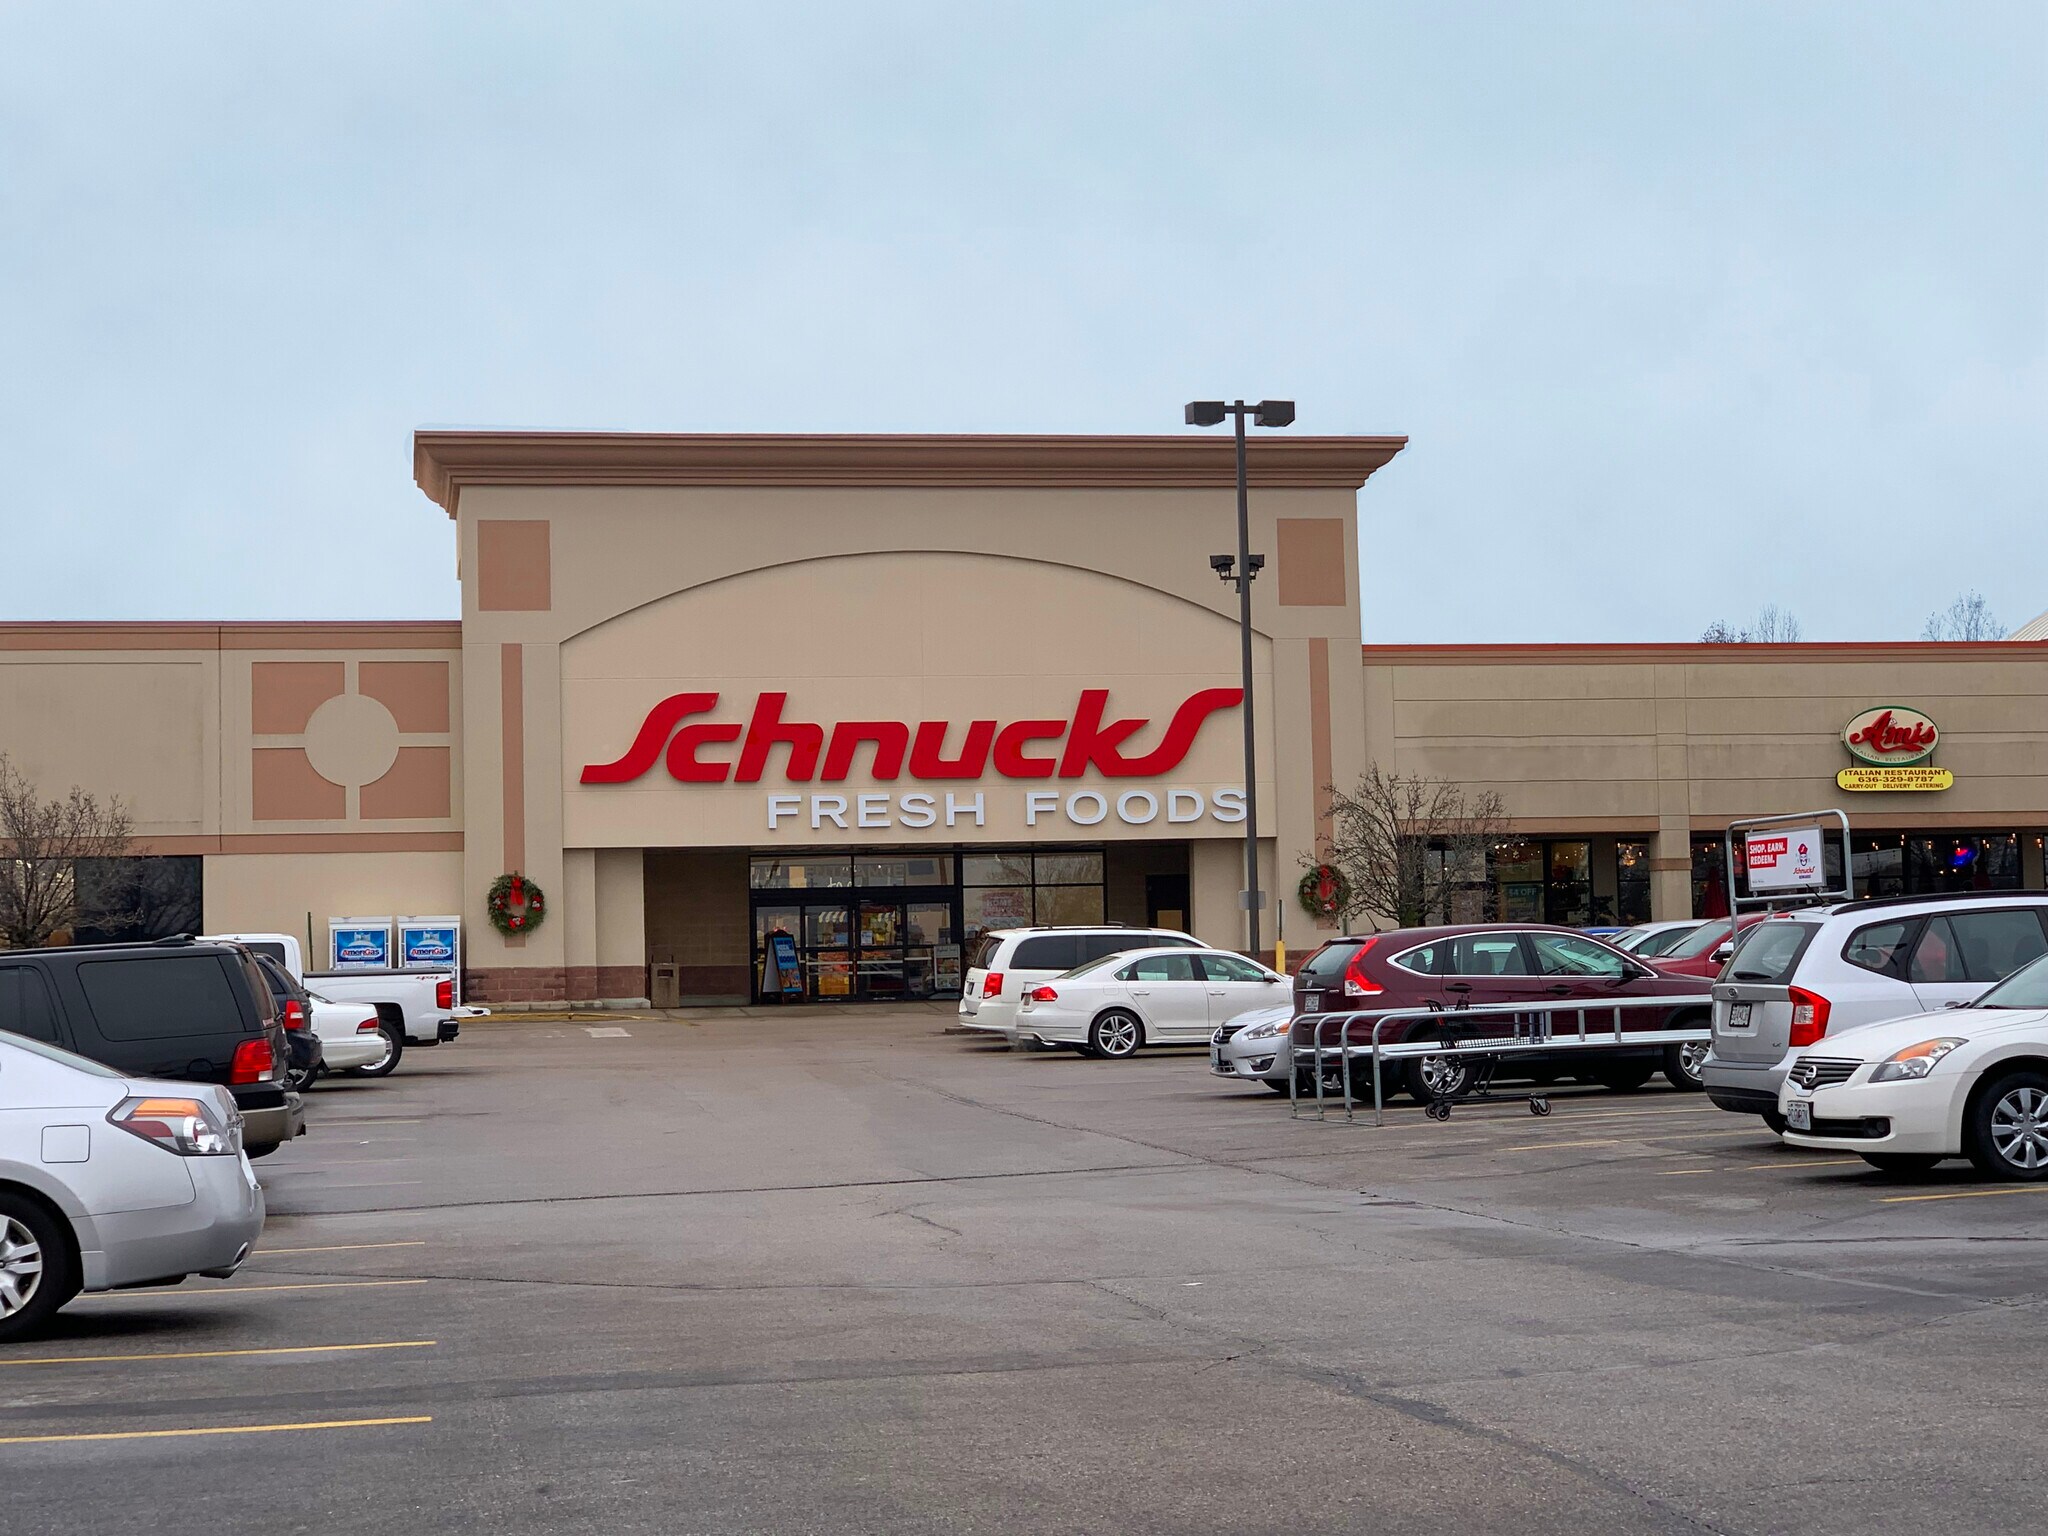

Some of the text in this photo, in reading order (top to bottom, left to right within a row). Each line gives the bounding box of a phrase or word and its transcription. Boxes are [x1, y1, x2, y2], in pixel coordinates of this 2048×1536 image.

[580, 688, 1244, 784] Schnucks
[768, 788, 1247, 830] FRESH FOODS
[1749, 842, 1786, 854] SHOP. EARN.
[1750, 855, 1775, 866] REDEEM.
[410, 948, 449, 956] AmeriGas
